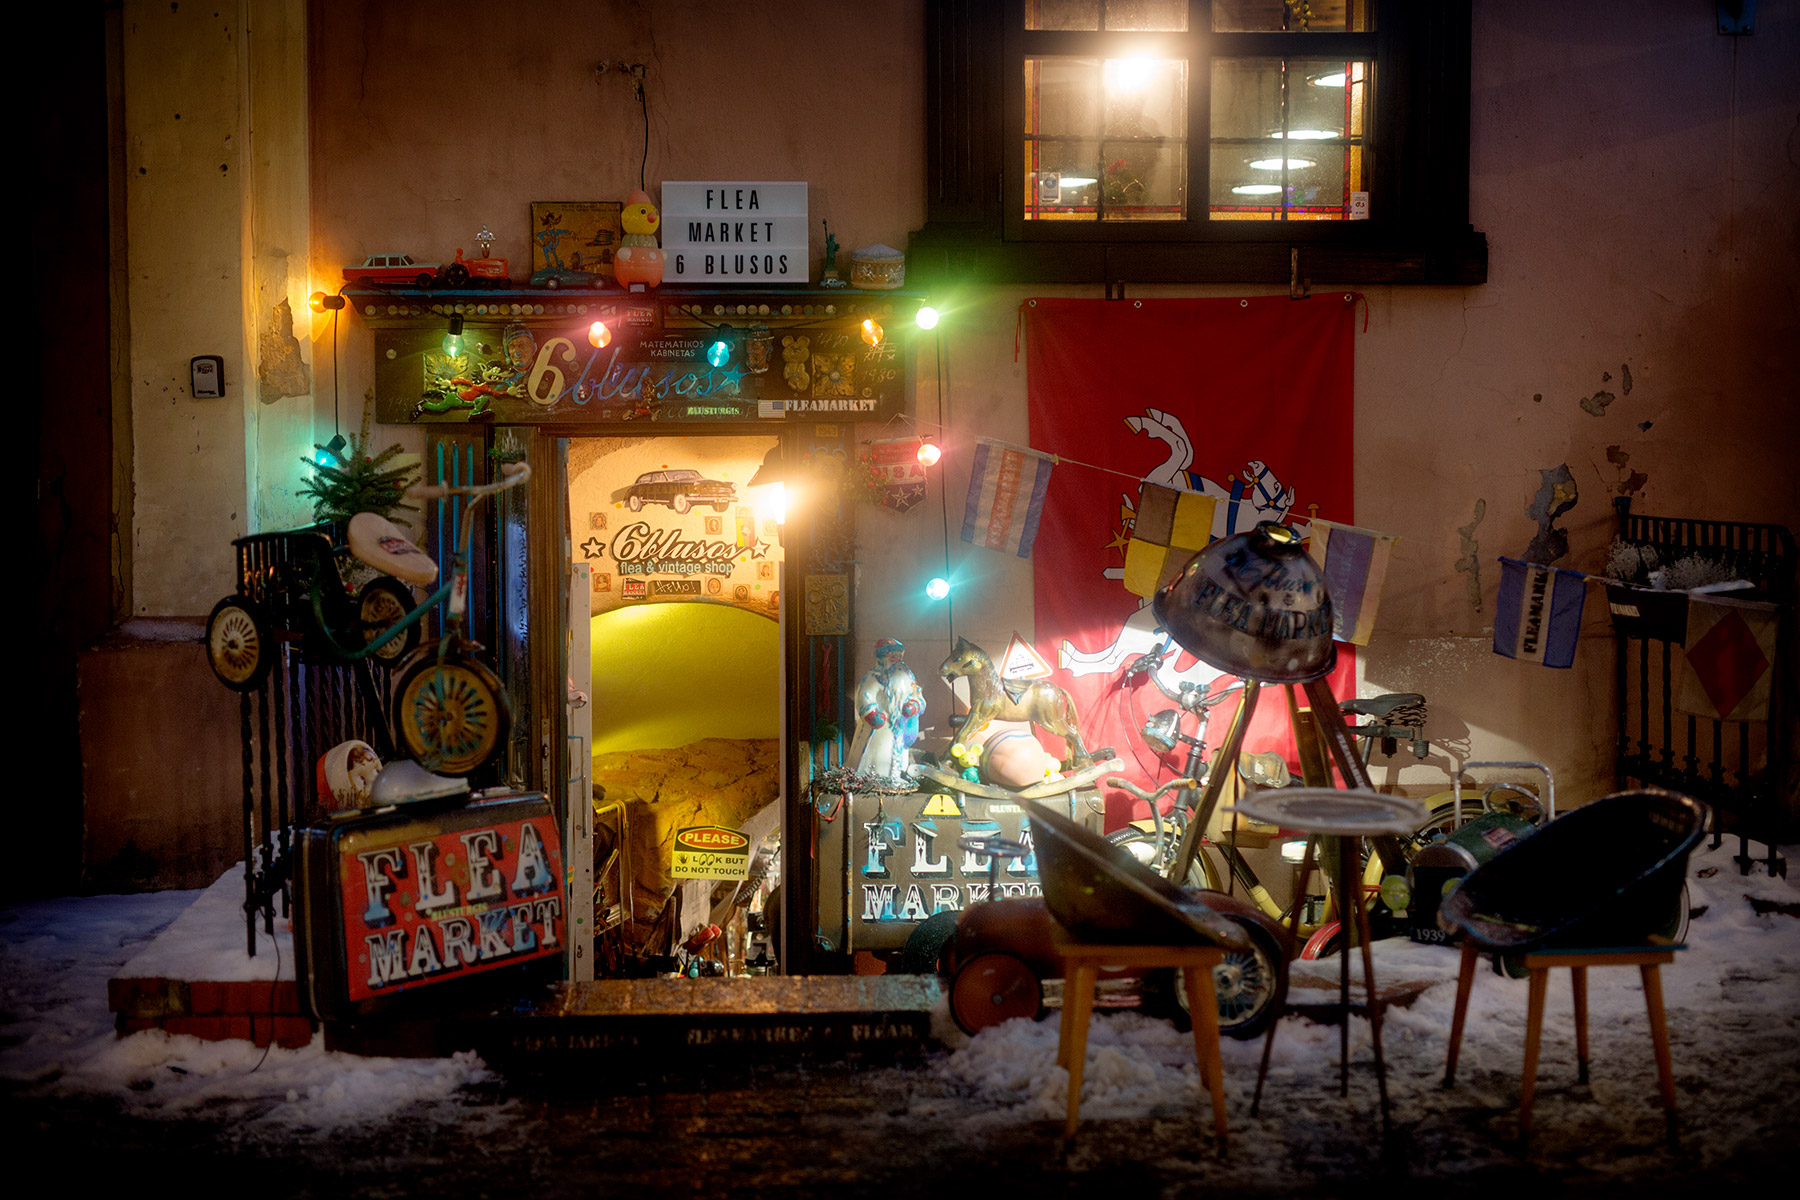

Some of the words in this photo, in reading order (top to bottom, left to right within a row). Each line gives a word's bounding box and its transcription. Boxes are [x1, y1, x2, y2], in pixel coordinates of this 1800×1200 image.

[706, 189, 759, 210] FLEA
[689, 222, 773, 242] MARKET
[676, 254, 685, 275] 6
[705, 254, 788, 275] BLUSOS
[640, 339, 705, 349] MATEMATIKOS
[651, 349, 696, 358] KABINETAS
[785, 399, 877, 411] FLEAMARKET
[620, 561, 643, 574] flea
[646, 562, 655, 574] &
[658, 561, 702, 575] vintage
[705, 561, 733, 576] shop
[623, 582, 645, 590] FLEA
[684, 832, 740, 845] PLEASE
[861, 820, 1040, 876] FLEA
[693, 853, 722, 866] LOOK
[725, 857, 745, 865] BUT
[357, 822, 556, 928] FLEA
[713, 867, 745, 876] TOUCH
[364, 896, 560, 988] MARKET
[1416, 928, 1446, 942] 1939
